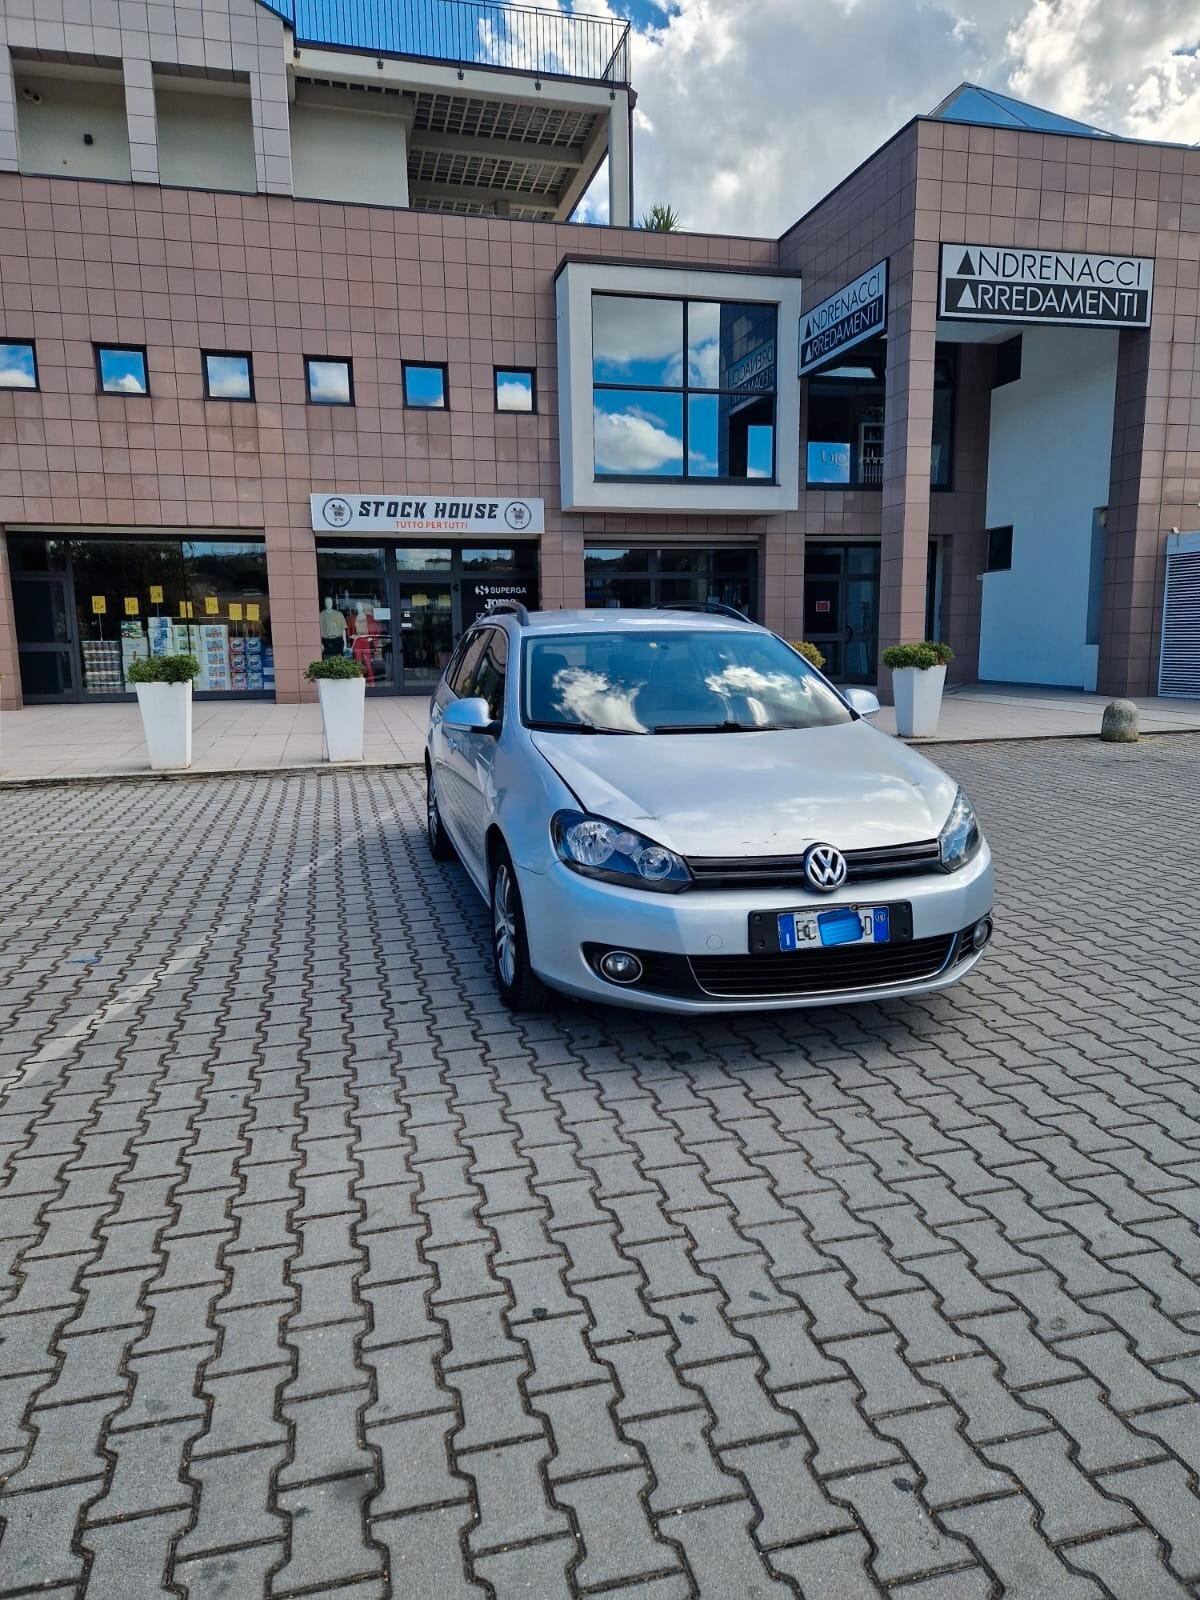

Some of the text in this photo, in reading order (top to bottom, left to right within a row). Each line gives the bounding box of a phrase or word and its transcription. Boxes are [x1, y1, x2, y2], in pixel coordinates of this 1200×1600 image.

[957, 250, 1141, 286] ANDRENACCI
[804, 272, 881, 338] ANDRENACCI
[957, 282, 1138, 317] ARREDAMENTI
[804, 304, 880, 362] ARREDAMENTI
[359, 501, 499, 519] STOCK HOUSE
[395, 521, 468, 529] TUTTO PER TUTTI
